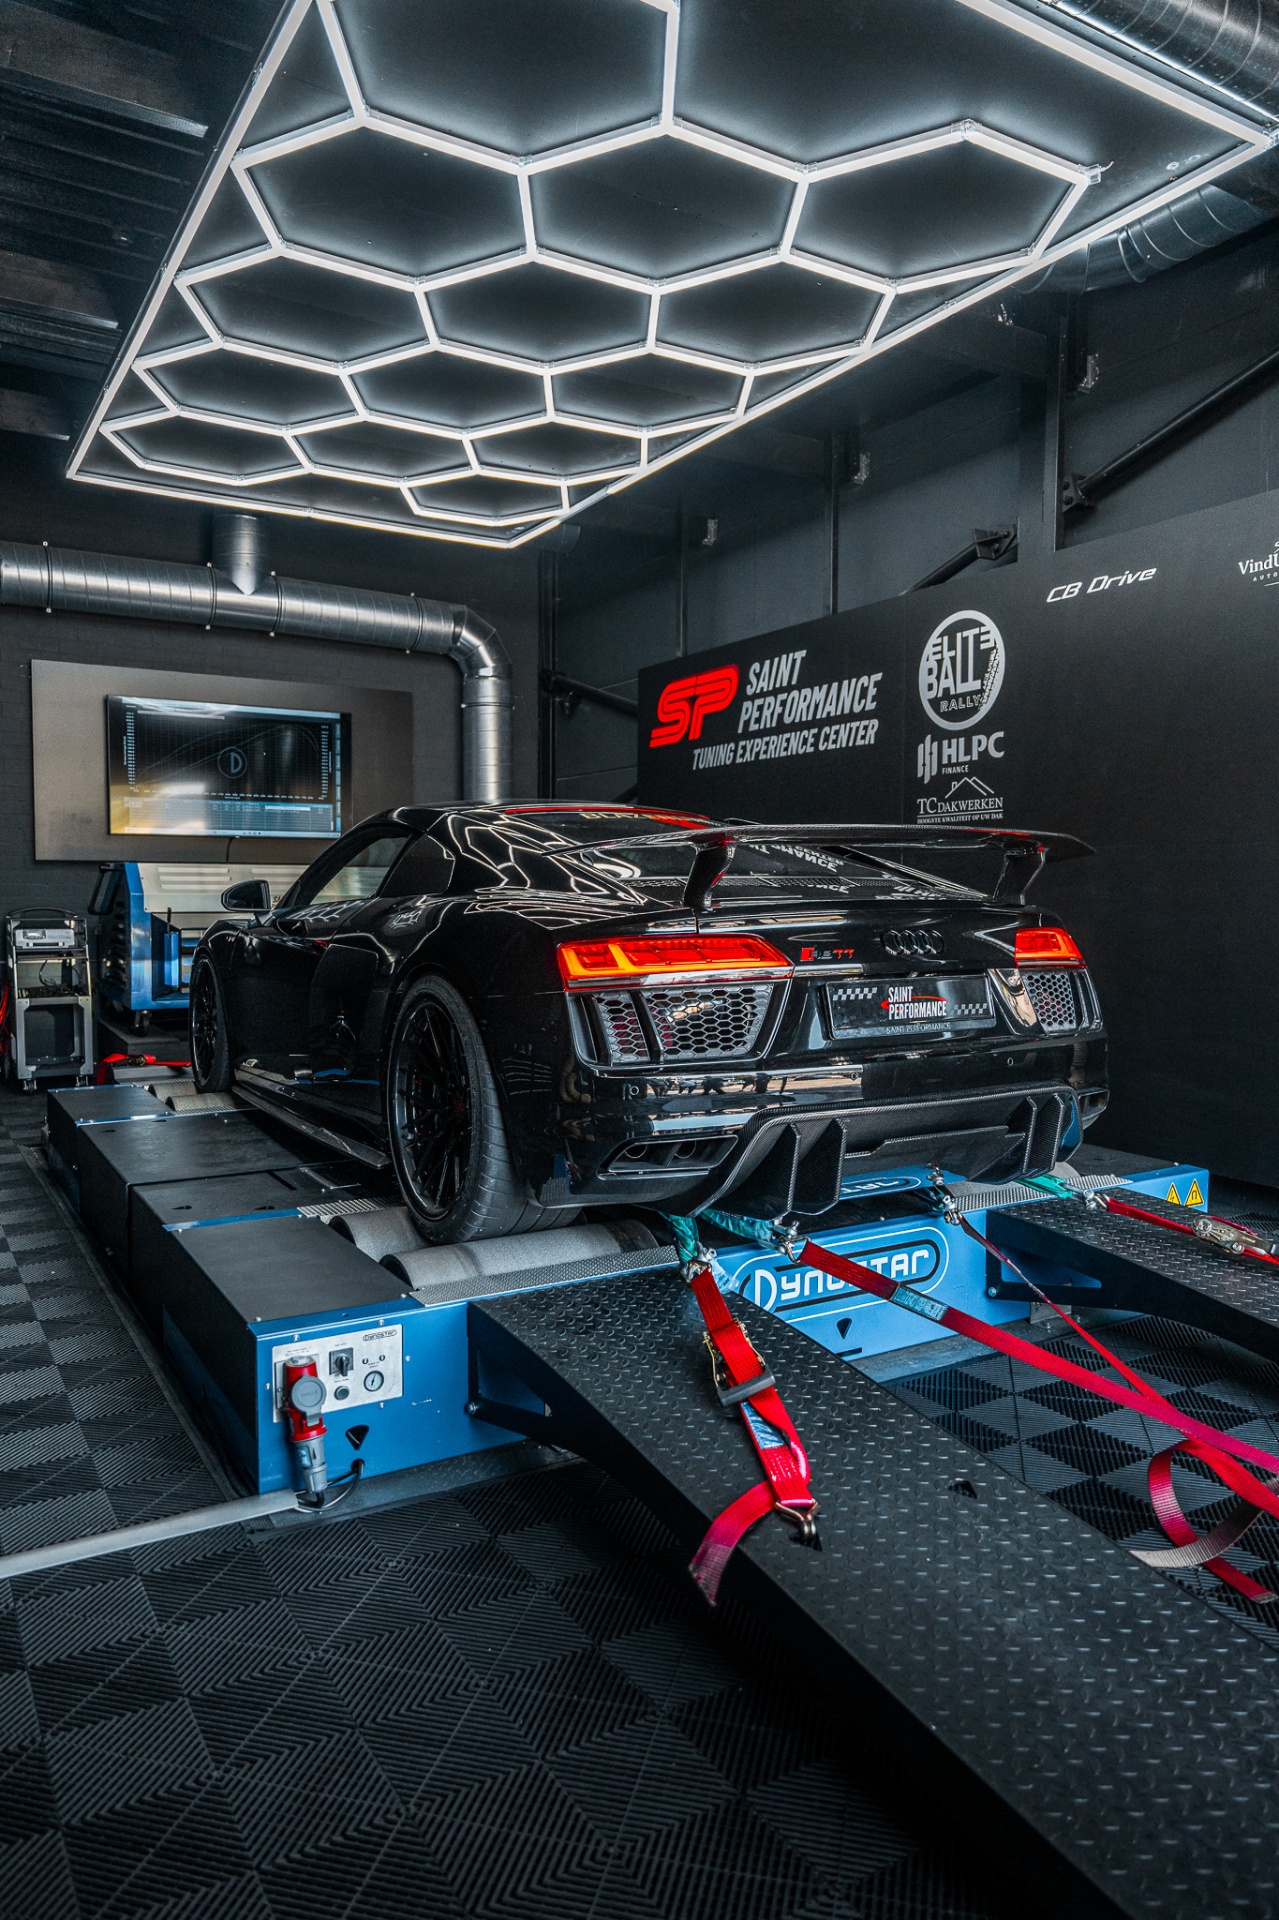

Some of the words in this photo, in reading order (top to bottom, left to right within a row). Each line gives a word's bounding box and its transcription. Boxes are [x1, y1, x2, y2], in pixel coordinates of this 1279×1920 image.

[1046, 581, 1083, 603] CB
[1086, 567, 1157, 594] Drive
[746, 649, 807, 696] SAINT
[649, 663, 740, 748] SP
[737, 672, 883, 734] PERFORMANCE
[940, 694, 982, 713] RALLY
[692, 742, 735, 771] TUNING
[735, 727, 818, 764] EXPERIENCE
[818, 718, 879, 752] CENTER
[942, 731, 1005, 765] HLPC
[942, 764, 969, 775] FINANCE
[916, 797, 937, 815] TC
[937, 797, 1004, 813] DAKWERKEN
[888, 986, 913, 1003] SAINT
[888, 1001, 947, 1020] PERFORMANCE
[886, 1025, 905, 1035] SAINT
[906, 1022, 952, 1032] PERFORMANCE
